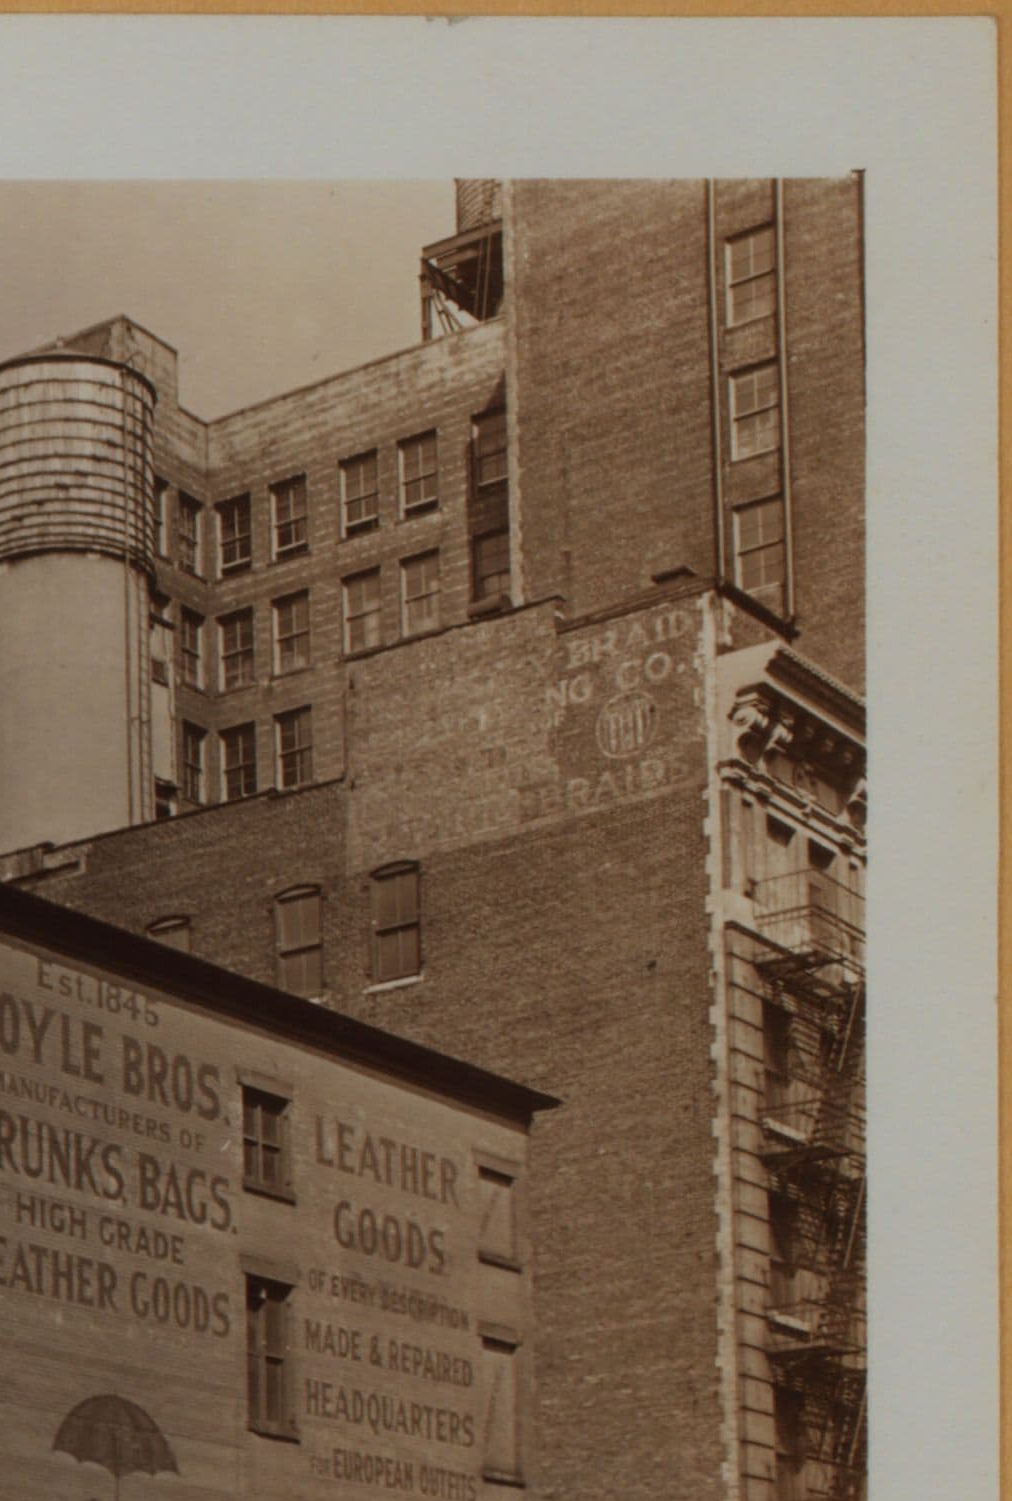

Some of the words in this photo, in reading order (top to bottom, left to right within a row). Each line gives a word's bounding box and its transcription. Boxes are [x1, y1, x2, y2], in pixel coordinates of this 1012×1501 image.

[181, 1129, 206, 1153] OF
[315, 1115, 460, 1208] LEATHER
[15, 1193, 88, 1241] HIGH
[99, 1216, 185, 1266] GRADE
[333, 1200, 446, 1276] GOODS
[130, 1271, 231, 1338] GOODS
[304, 1318, 362, 1362] MADE
[369, 1335, 383, 1367] &
[389, 1341, 474, 1389] REPAIRED
[306, 1378, 475, 1450] HEADQUARTERS
[333, 1448, 414, 1492] EUROPEAN
